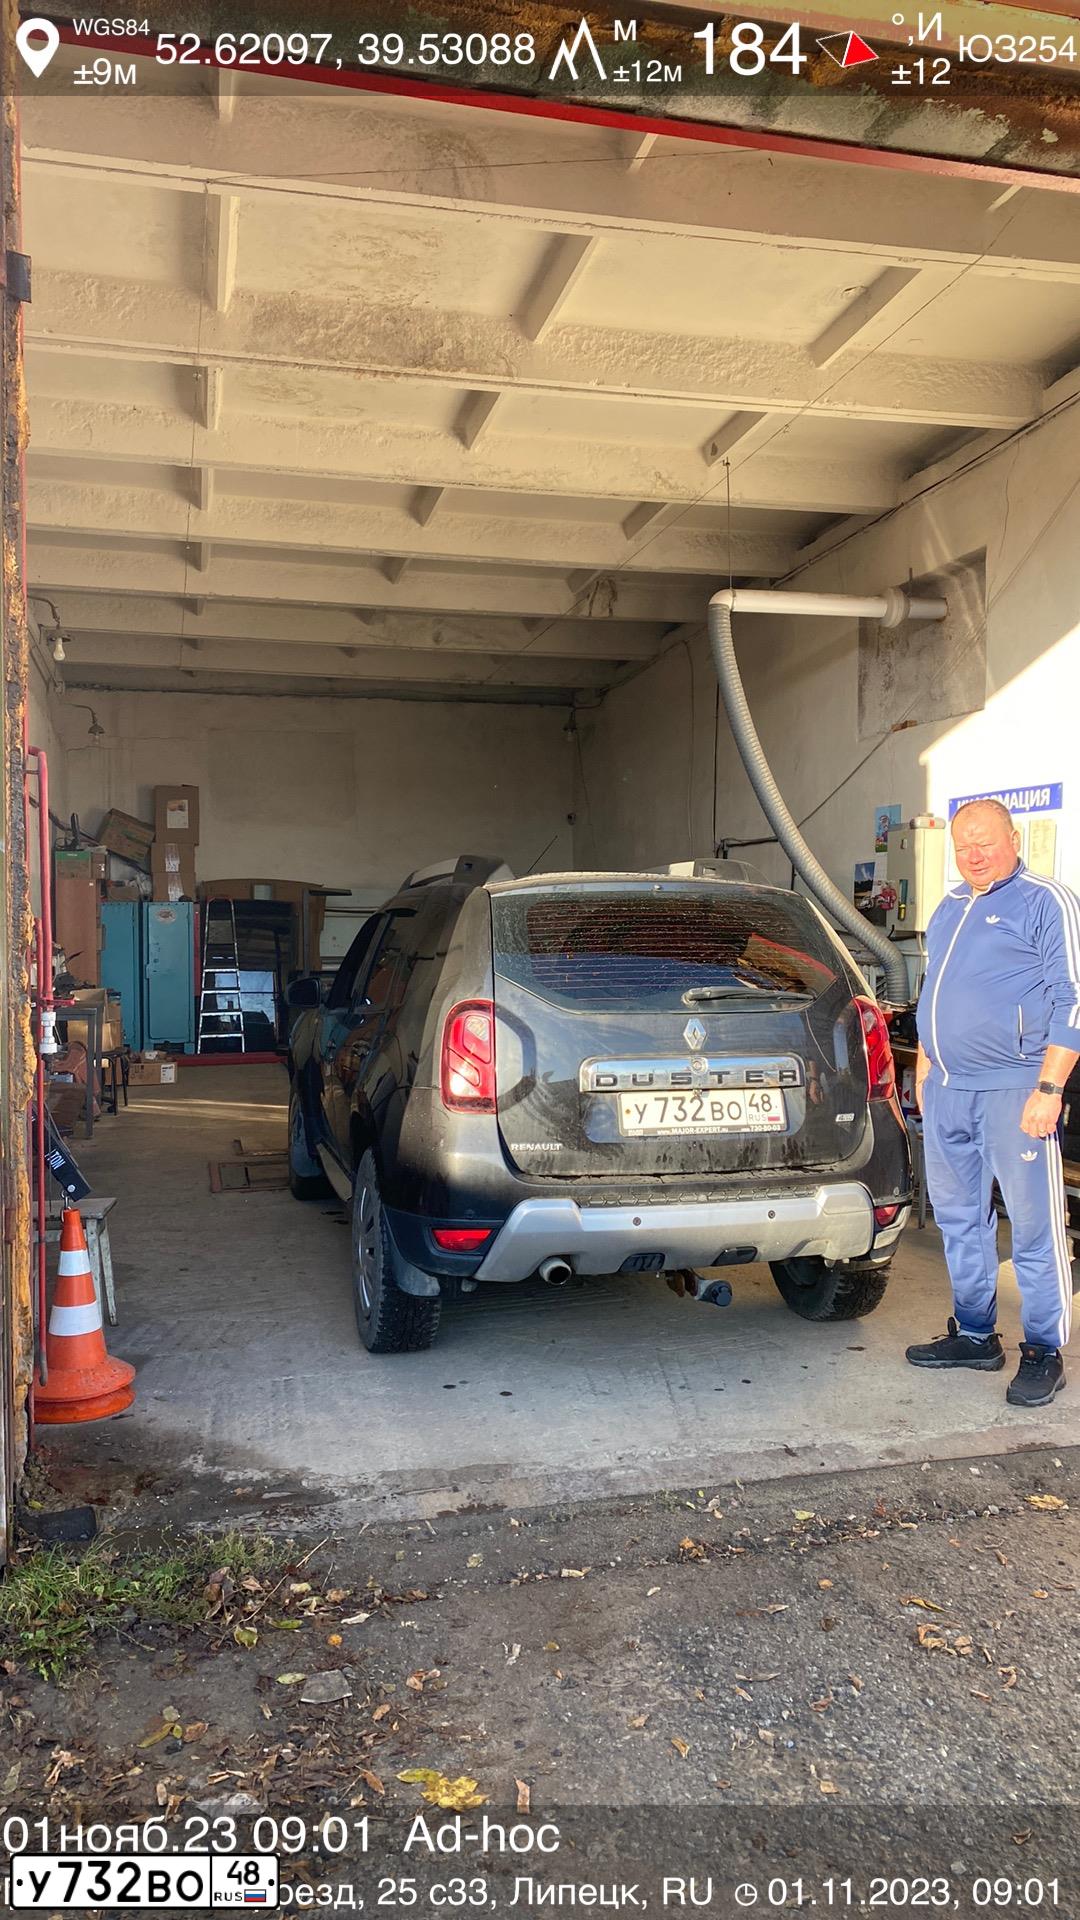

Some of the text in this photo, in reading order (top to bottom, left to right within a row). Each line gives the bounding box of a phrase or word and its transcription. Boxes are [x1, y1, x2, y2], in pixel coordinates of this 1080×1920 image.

[595, 1069, 798, 1088] DUSTER
[748, 1092, 773, 1113] 48
[748, 1114, 767, 1122] RUS
[510, 1142, 563, 1151] RENAULT
